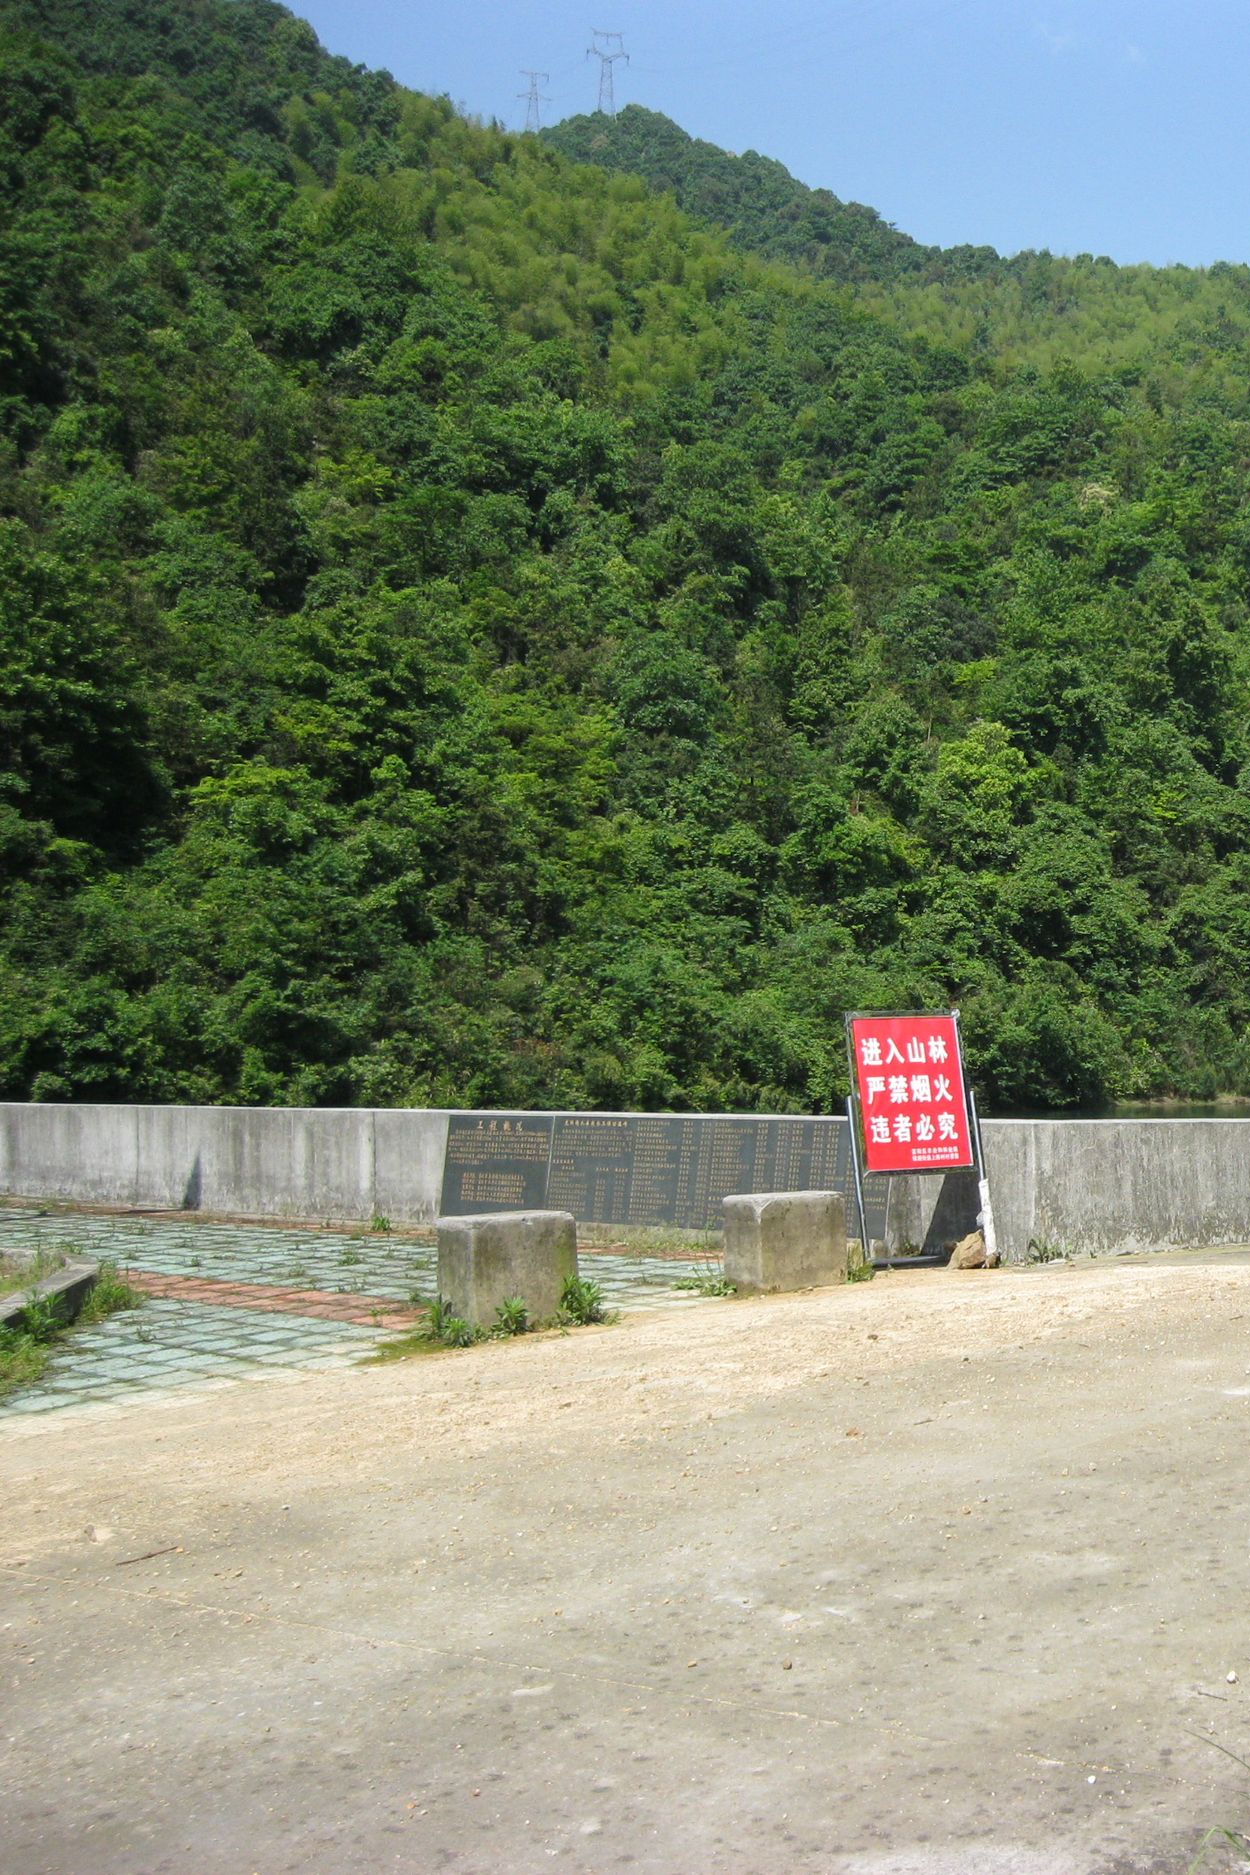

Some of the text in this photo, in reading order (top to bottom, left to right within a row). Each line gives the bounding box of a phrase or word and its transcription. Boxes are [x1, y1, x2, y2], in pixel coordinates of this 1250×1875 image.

[861, 1035, 949, 1066] 进入山林
[866, 1074, 954, 1105] 严禁烟火
[870, 1112, 959, 1144] 违者必究
